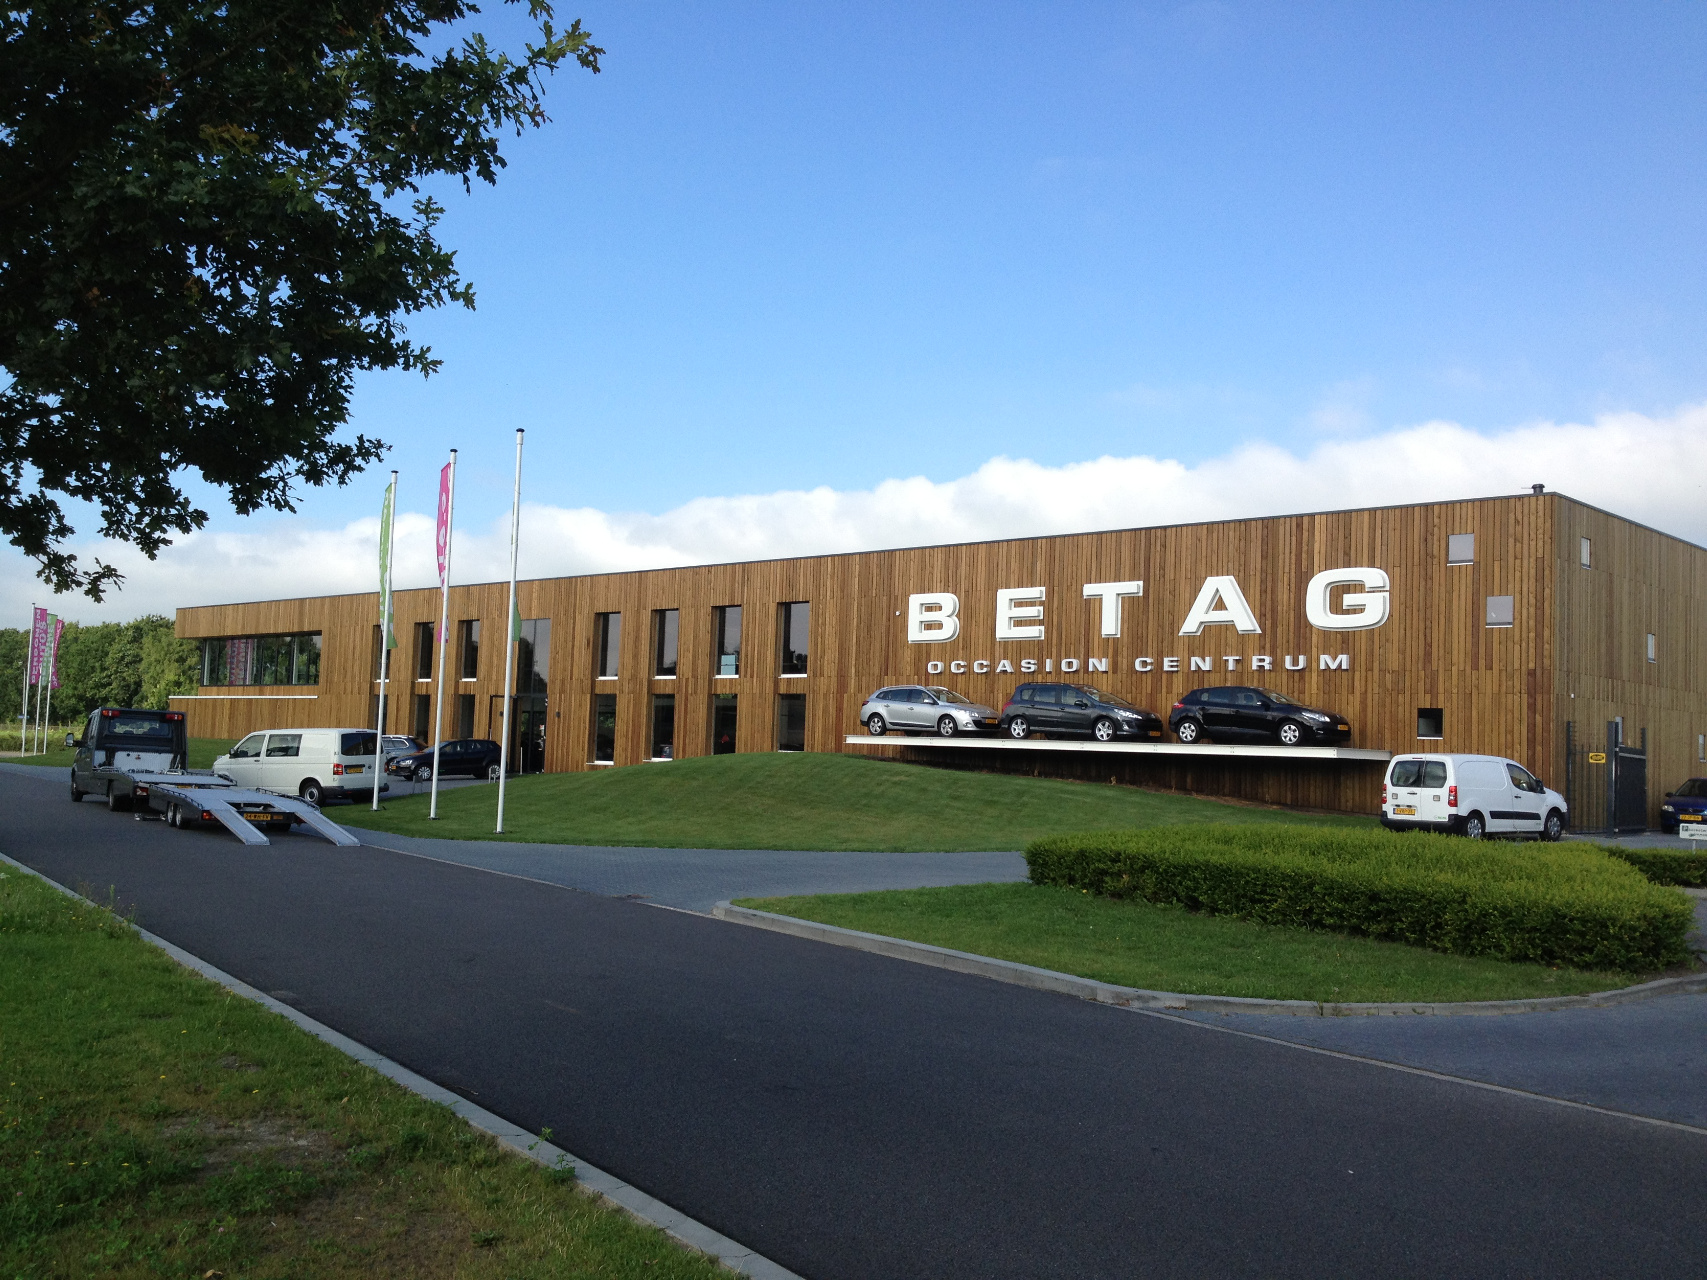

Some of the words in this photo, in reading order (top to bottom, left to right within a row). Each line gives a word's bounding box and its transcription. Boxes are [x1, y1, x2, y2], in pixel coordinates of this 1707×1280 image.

[907, 567, 1391, 644] BETAG
[927, 657, 1109, 674] OCCASION
[1134, 654, 1350, 672] CENTRUM
